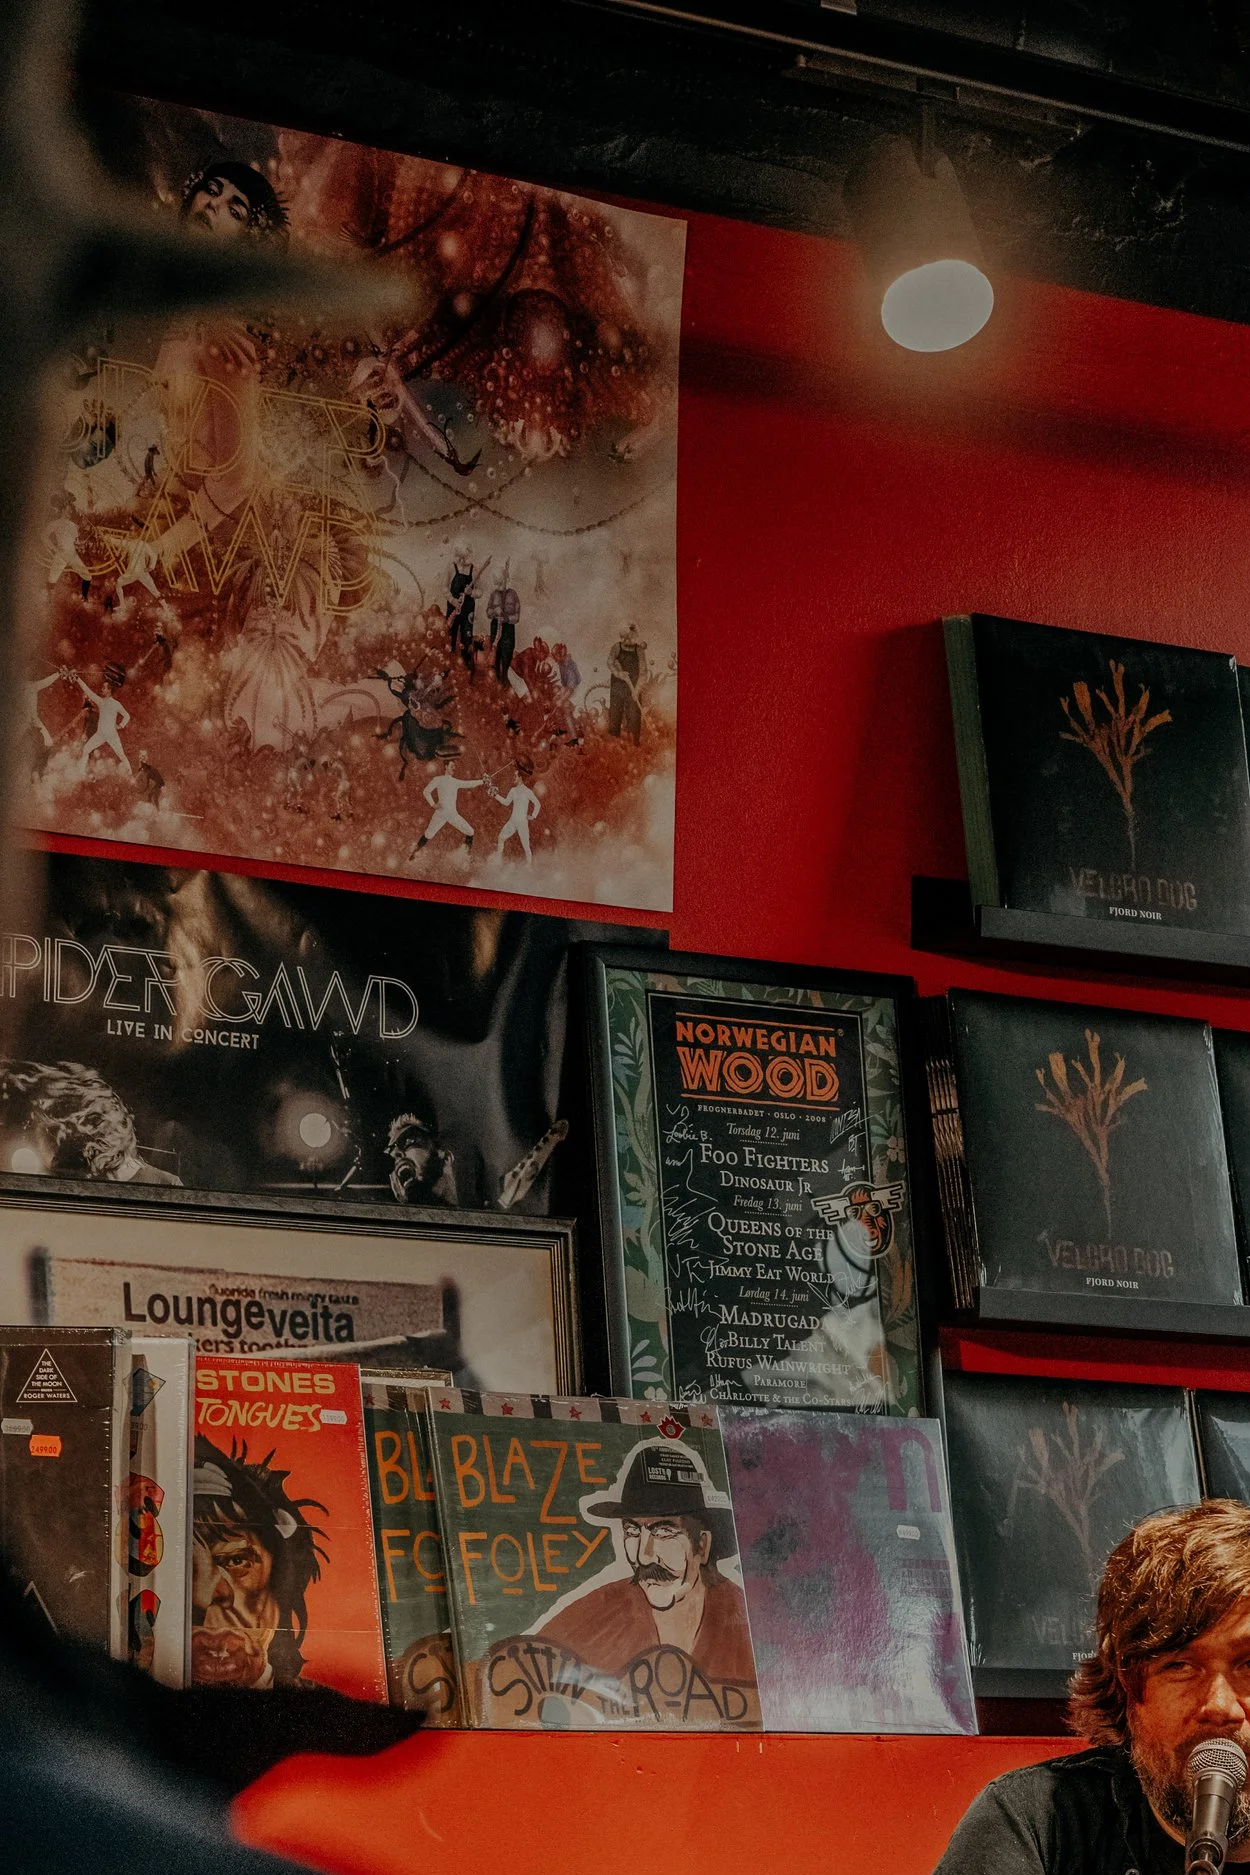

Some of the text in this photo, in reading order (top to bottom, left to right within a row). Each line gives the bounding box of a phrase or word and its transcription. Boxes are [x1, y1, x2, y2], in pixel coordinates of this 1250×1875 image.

[1109, 906, 1162, 920] FJORD NOIR
[197, 956, 421, 1041] GAWD
[106, 1018, 260, 1050] LIVE IN CONCERT
[676, 1020, 837, 1057] NORWEGIAN
[676, 1046, 839, 1101] WOOD
[697, 1104, 764, 1118] FROGNERBADET
[774, 1111, 796, 1120] OSLO
[805, 1115, 827, 1123] 2008
[726, 1122, 762, 1140] Torsdag
[765, 1126, 780, 1139] 12.
[781, 1127, 800, 1142] juni
[700, 1143, 738, 1166] FOO
[743, 1147, 829, 1174] FIGHTERS
[720, 1170, 794, 1192] DINOSAUR
[733, 1195, 802, 1213] Fredag 13. juni
[708, 1212, 834, 1241] QUEENS OF THE
[723, 1235, 824, 1262] STONE AGE
[709, 1260, 751, 1280] JIMMY
[756, 1264, 782, 1280] EAT
[785, 1266, 835, 1284] WORLD
[1085, 1277, 1139, 1290] FJORD NOIR
[774, 1288, 789, 1301] 14.
[791, 1289, 809, 1304] juni
[719, 1304, 827, 1331] MADRUGAD
[728, 1331, 770, 1350] BILLY
[773, 1333, 827, 1353] TALENT
[706, 1352, 850, 1376] RUFUS WAINWRIGHT
[196, 1369, 336, 1395] STONES
[754, 1375, 807, 1389] PARAMORE
[710, 1388, 769, 1404] CHARLOTTE
[772, 1394, 781, 1404] &
[196, 1397, 322, 1432] TONGUES
[450, 1434, 608, 1525] BLAZE
[457, 1527, 609, 1609] FOLEY
[629, 1648, 748, 1722] ROAD
